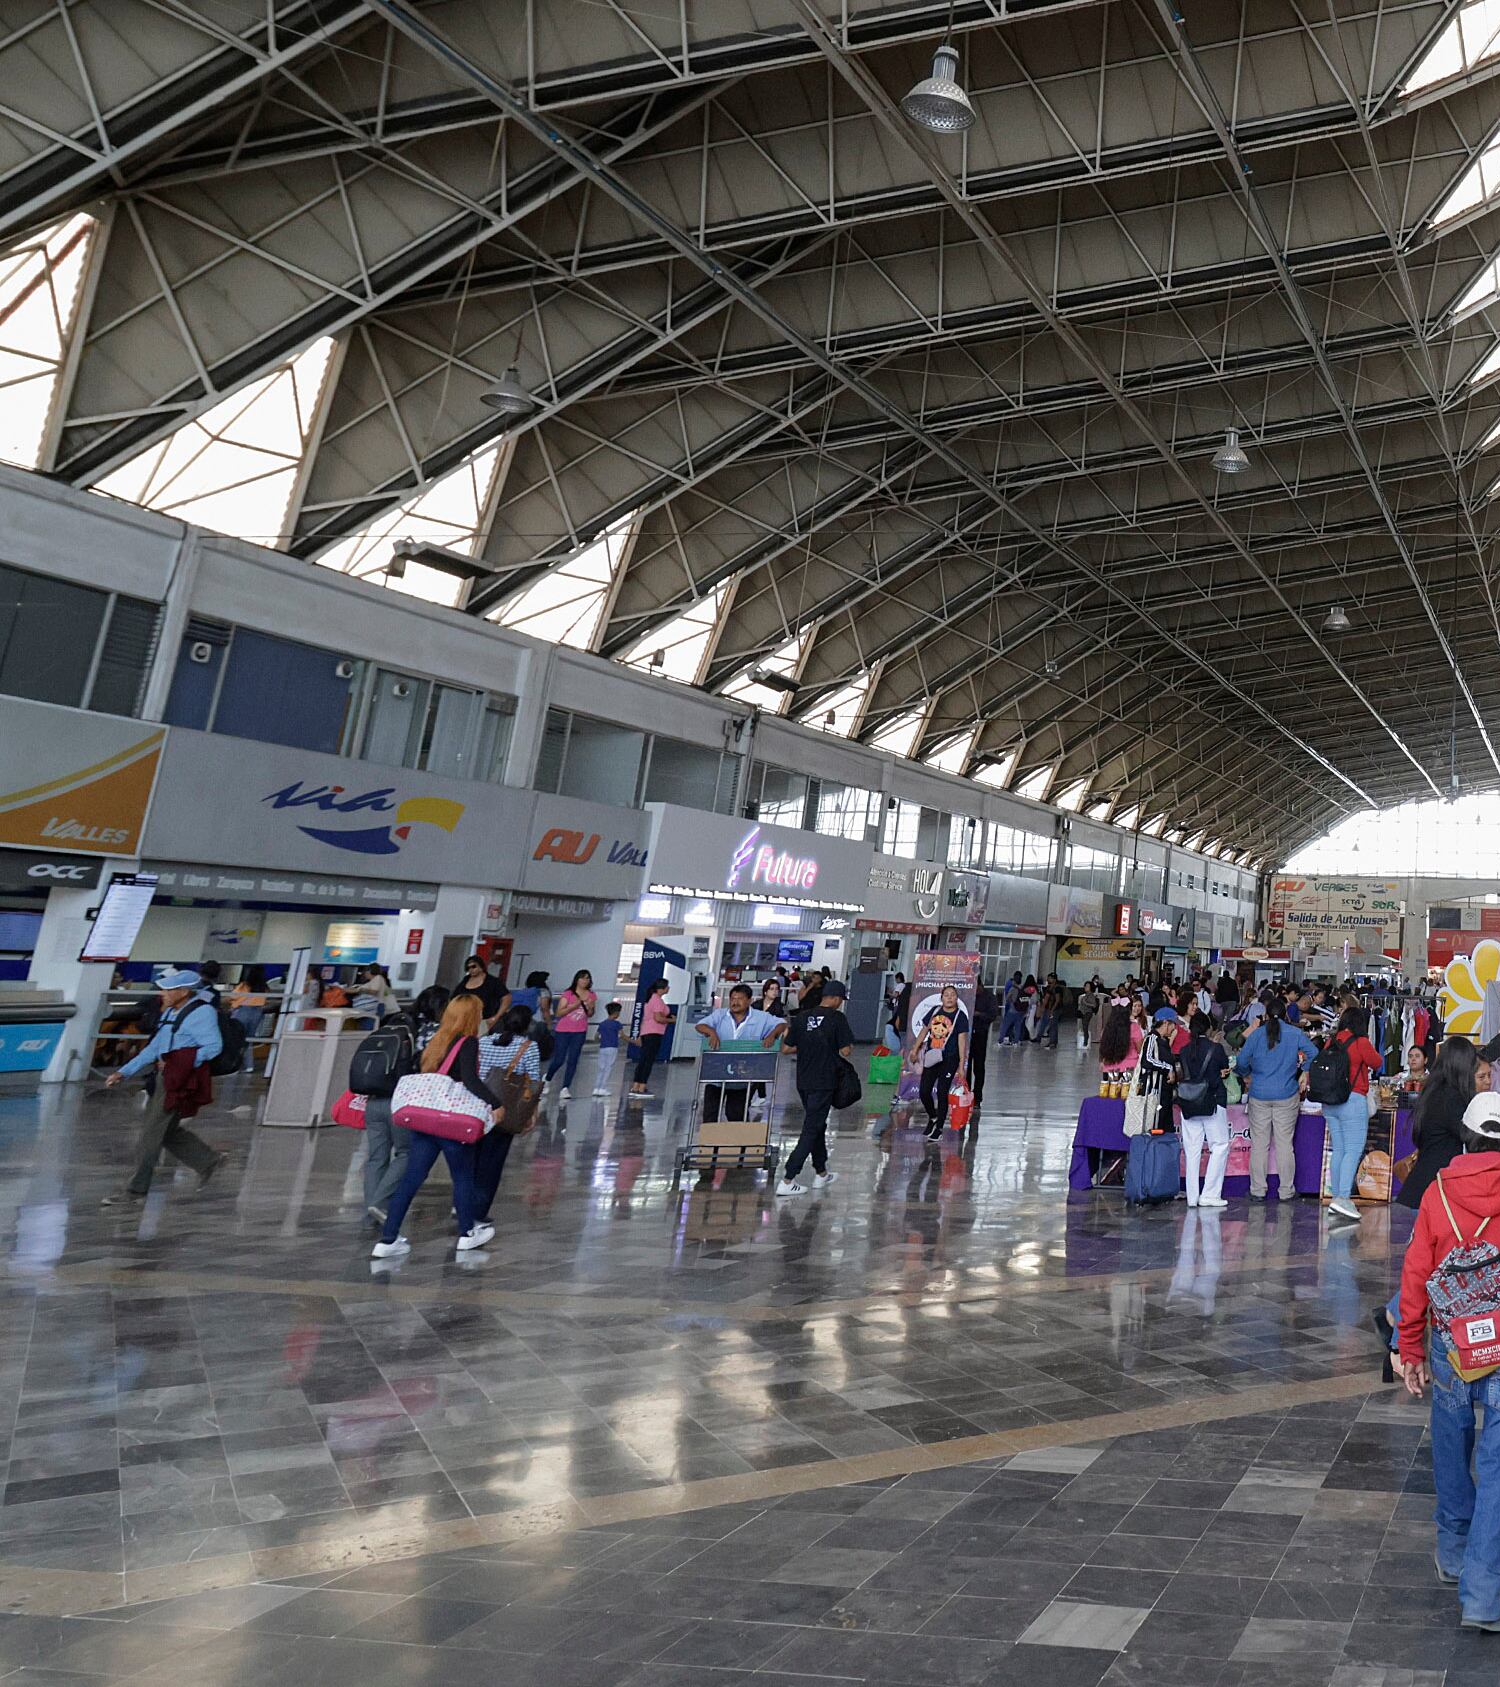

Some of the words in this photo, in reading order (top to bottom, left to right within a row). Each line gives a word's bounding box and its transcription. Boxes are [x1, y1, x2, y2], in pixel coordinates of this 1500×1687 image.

[40, 817, 129, 843] VALLES
[533, 829, 602, 864] AU
[27, 863, 93, 879] OCC
[752, 846, 819, 889] Futura
[1287, 912, 1317, 923] Salida
[1320, 913, 1333, 924] de
[1334, 914, 1389, 926] Autobuses
[643, 951, 665, 959] BBVA
[1470, 1325, 1493, 1337] FB
